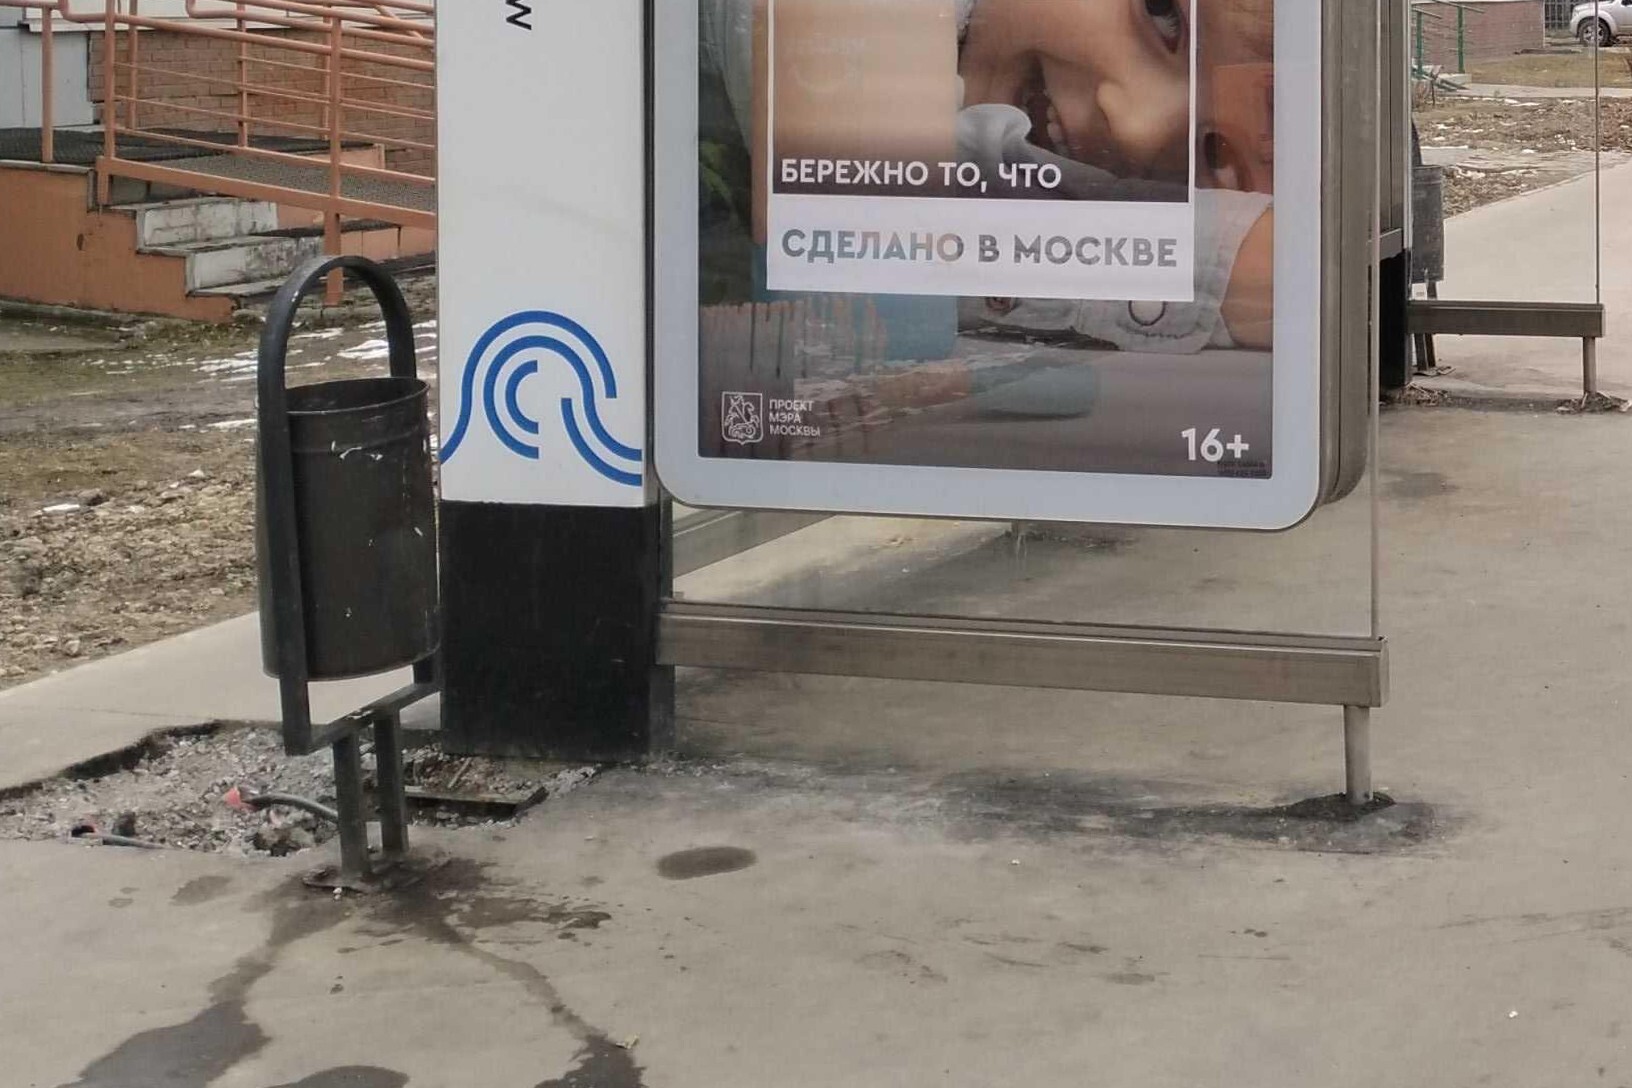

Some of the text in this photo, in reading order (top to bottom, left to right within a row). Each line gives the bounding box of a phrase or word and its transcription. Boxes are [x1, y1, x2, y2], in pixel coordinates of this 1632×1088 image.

[781, 158, 1062, 193] БЕРЕЖНО ТО, ЧТО
[782, 228, 1178, 268] СДЕЛАНО В МОСКВЕ
[769, 399, 815, 412] ПРОЕКТ
[769, 412, 801, 424] МЭРА
[769, 424, 821, 437] МОСКВЫ
[1181, 428, 1249, 462] 16+
